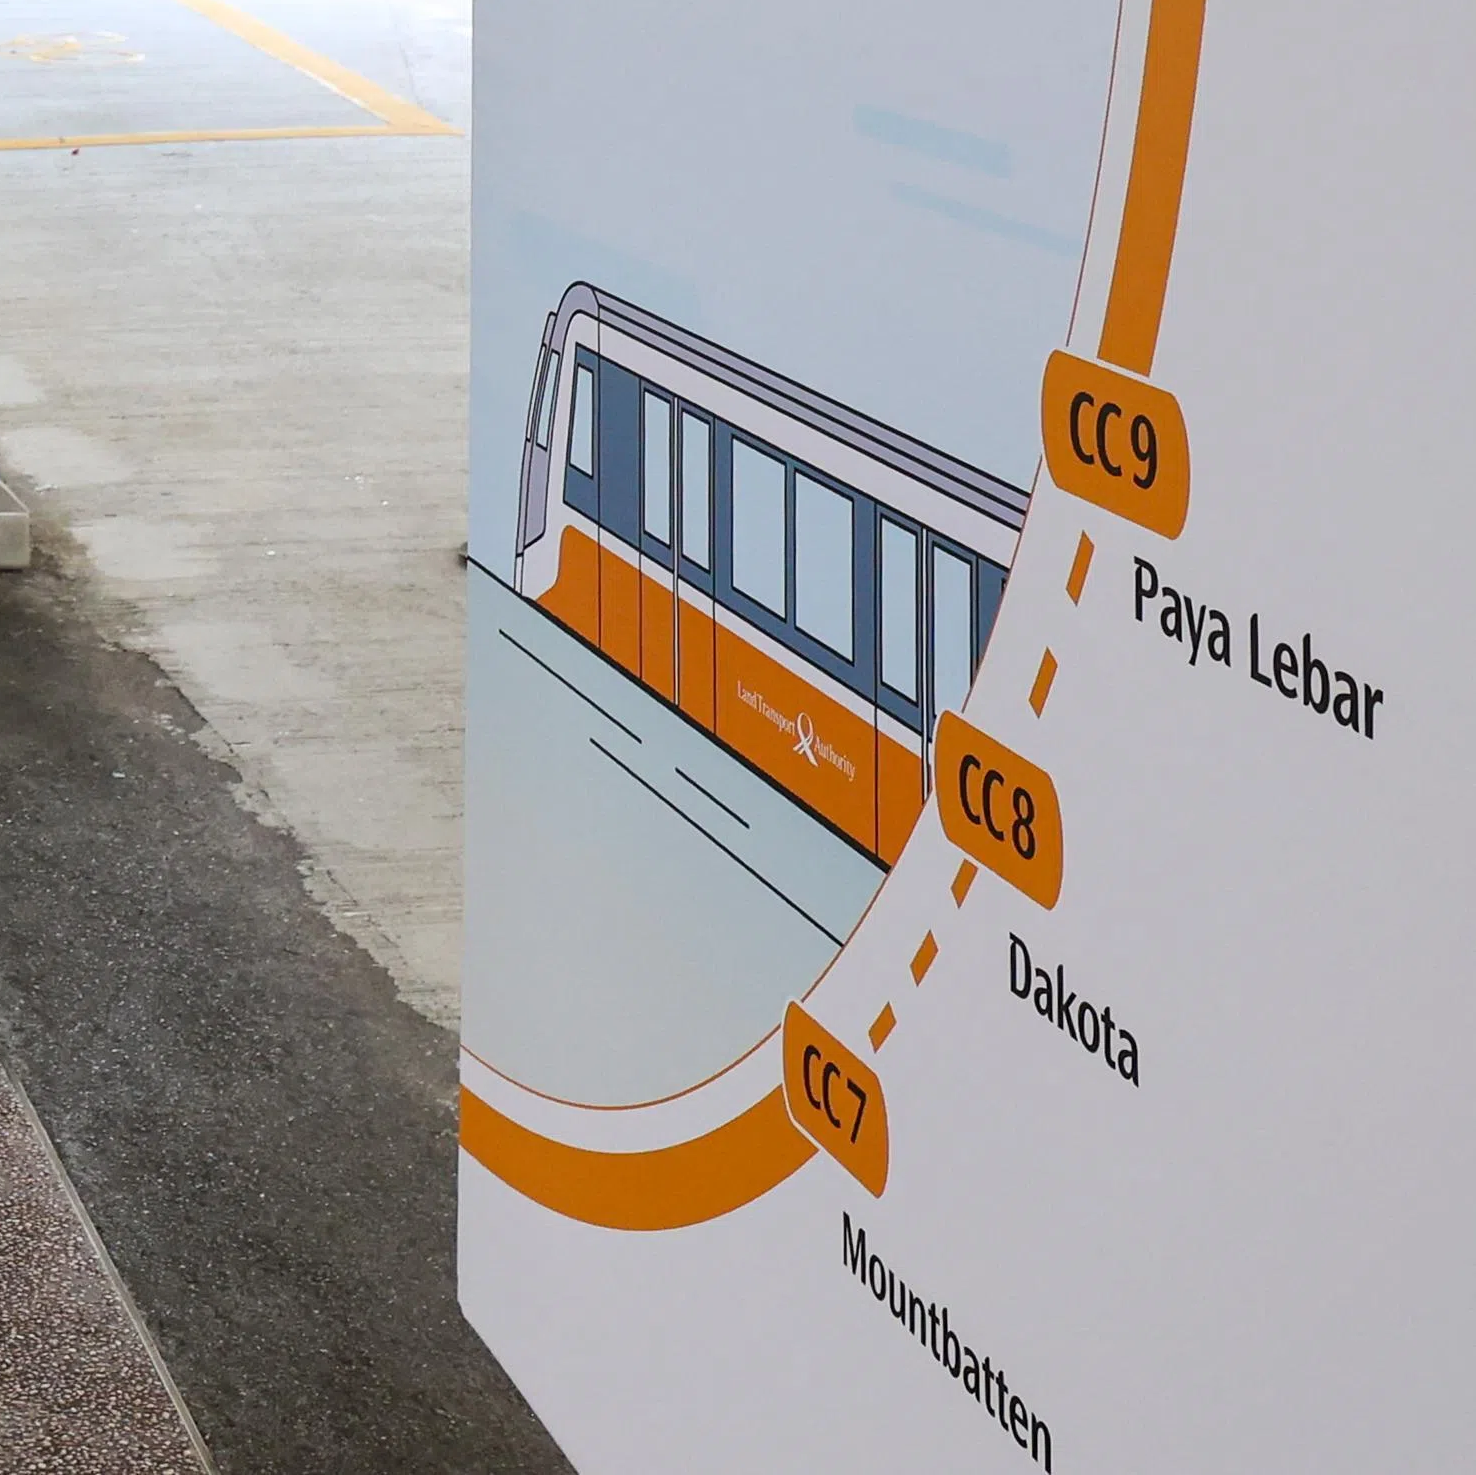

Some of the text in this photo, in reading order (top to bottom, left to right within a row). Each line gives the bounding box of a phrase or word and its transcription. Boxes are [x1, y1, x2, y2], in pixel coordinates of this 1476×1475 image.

[736, 679, 856, 783] Land Transport Authority
[1133, 555, 1384, 741] Paya Lebar
[1008, 930, 1140, 1089] Dakota
[842, 1209, 1053, 1475] Mountbatten
